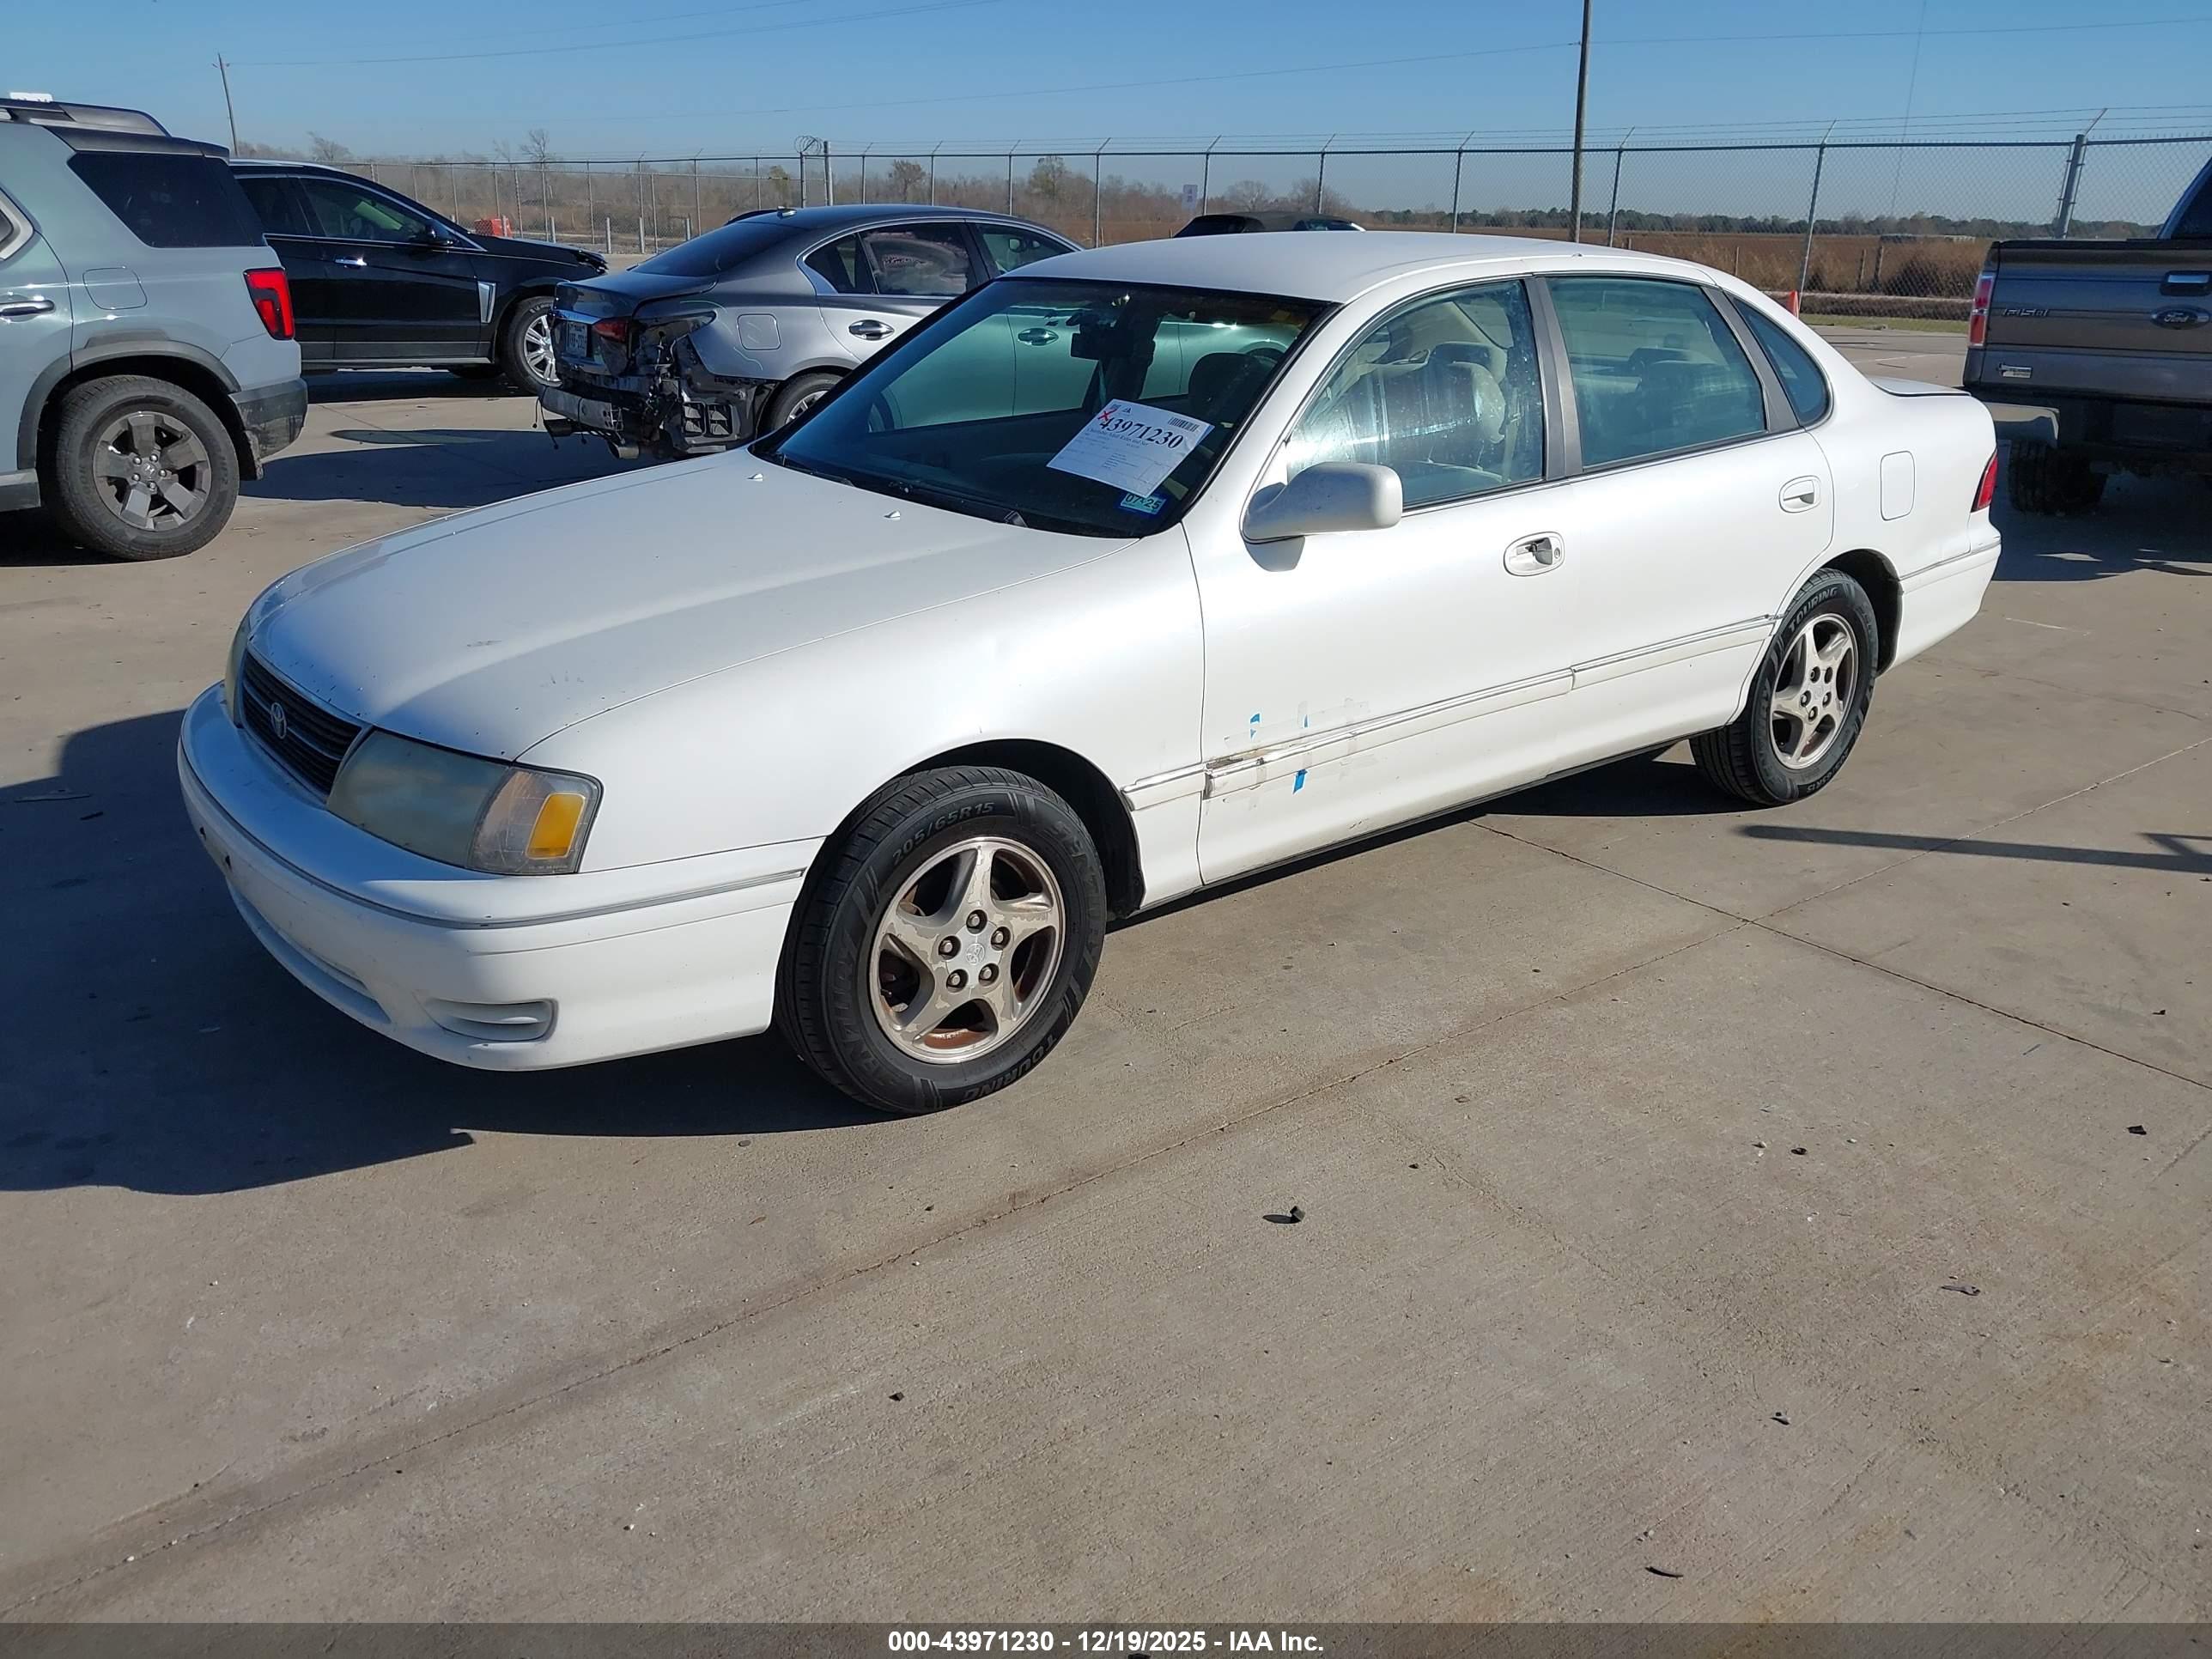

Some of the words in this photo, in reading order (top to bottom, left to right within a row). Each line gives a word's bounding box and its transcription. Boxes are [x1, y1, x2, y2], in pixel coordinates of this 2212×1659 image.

[2163, 312, 2190, 323] Ford
[1099, 416, 1184, 449] 43971230
[1143, 498, 1162, 509] 25
[1789, 587, 1838, 634] TOURING
[890, 800, 995, 866] 205/65R15
